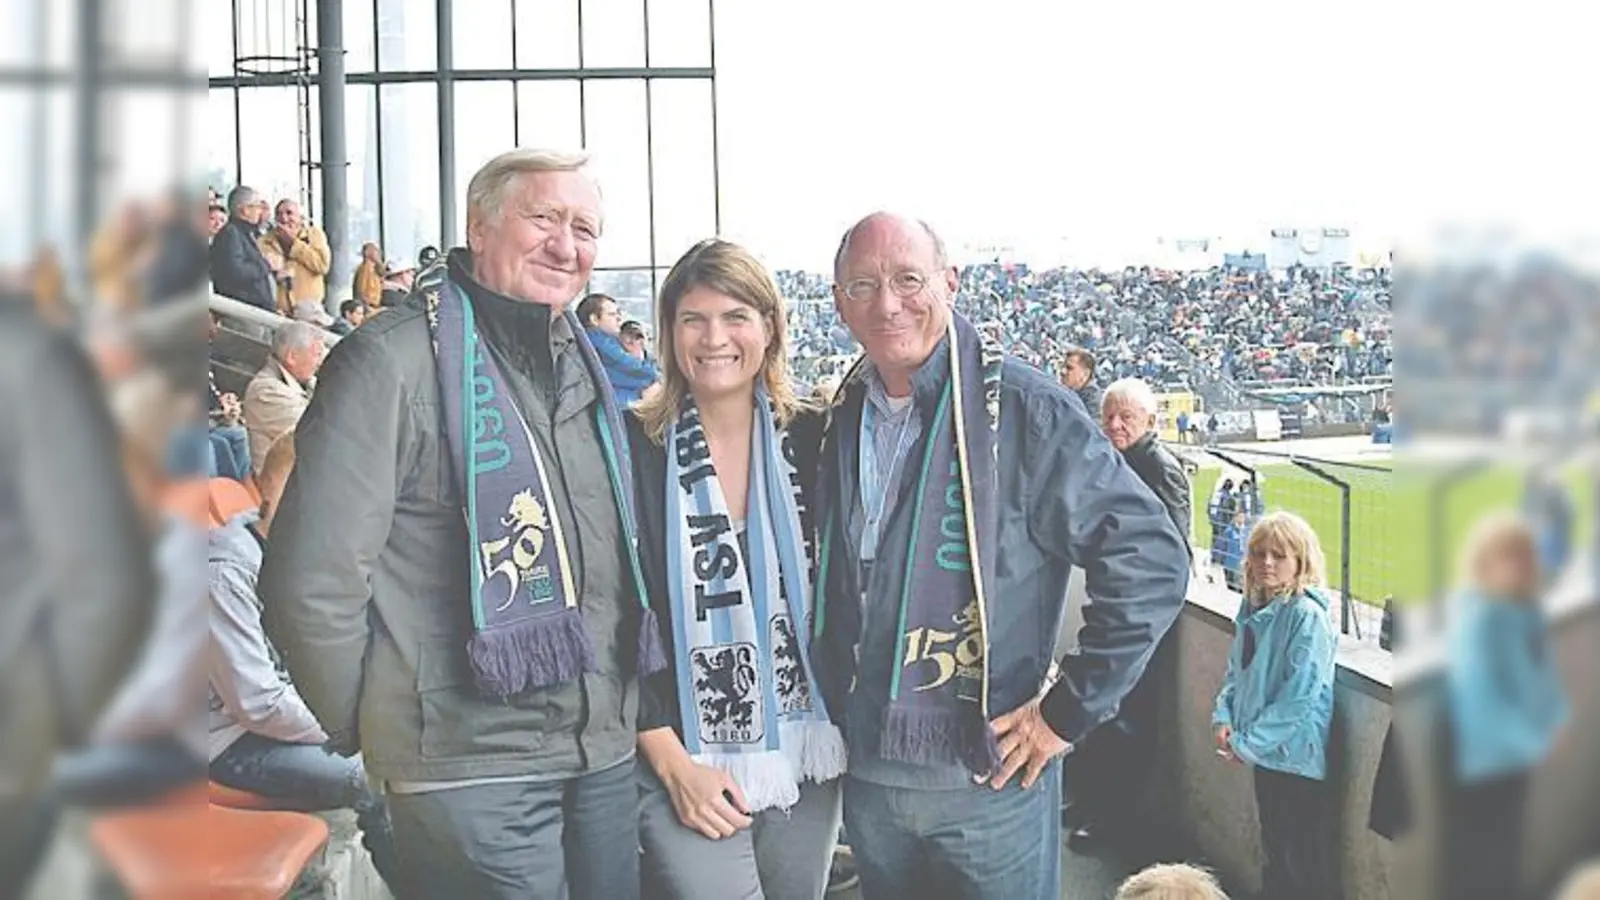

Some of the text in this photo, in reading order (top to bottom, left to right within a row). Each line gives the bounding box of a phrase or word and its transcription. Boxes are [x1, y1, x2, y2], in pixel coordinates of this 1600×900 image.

[479, 527, 545, 612] 50
[686, 514, 744, 623] TSV
[903, 627, 983, 692] 150
